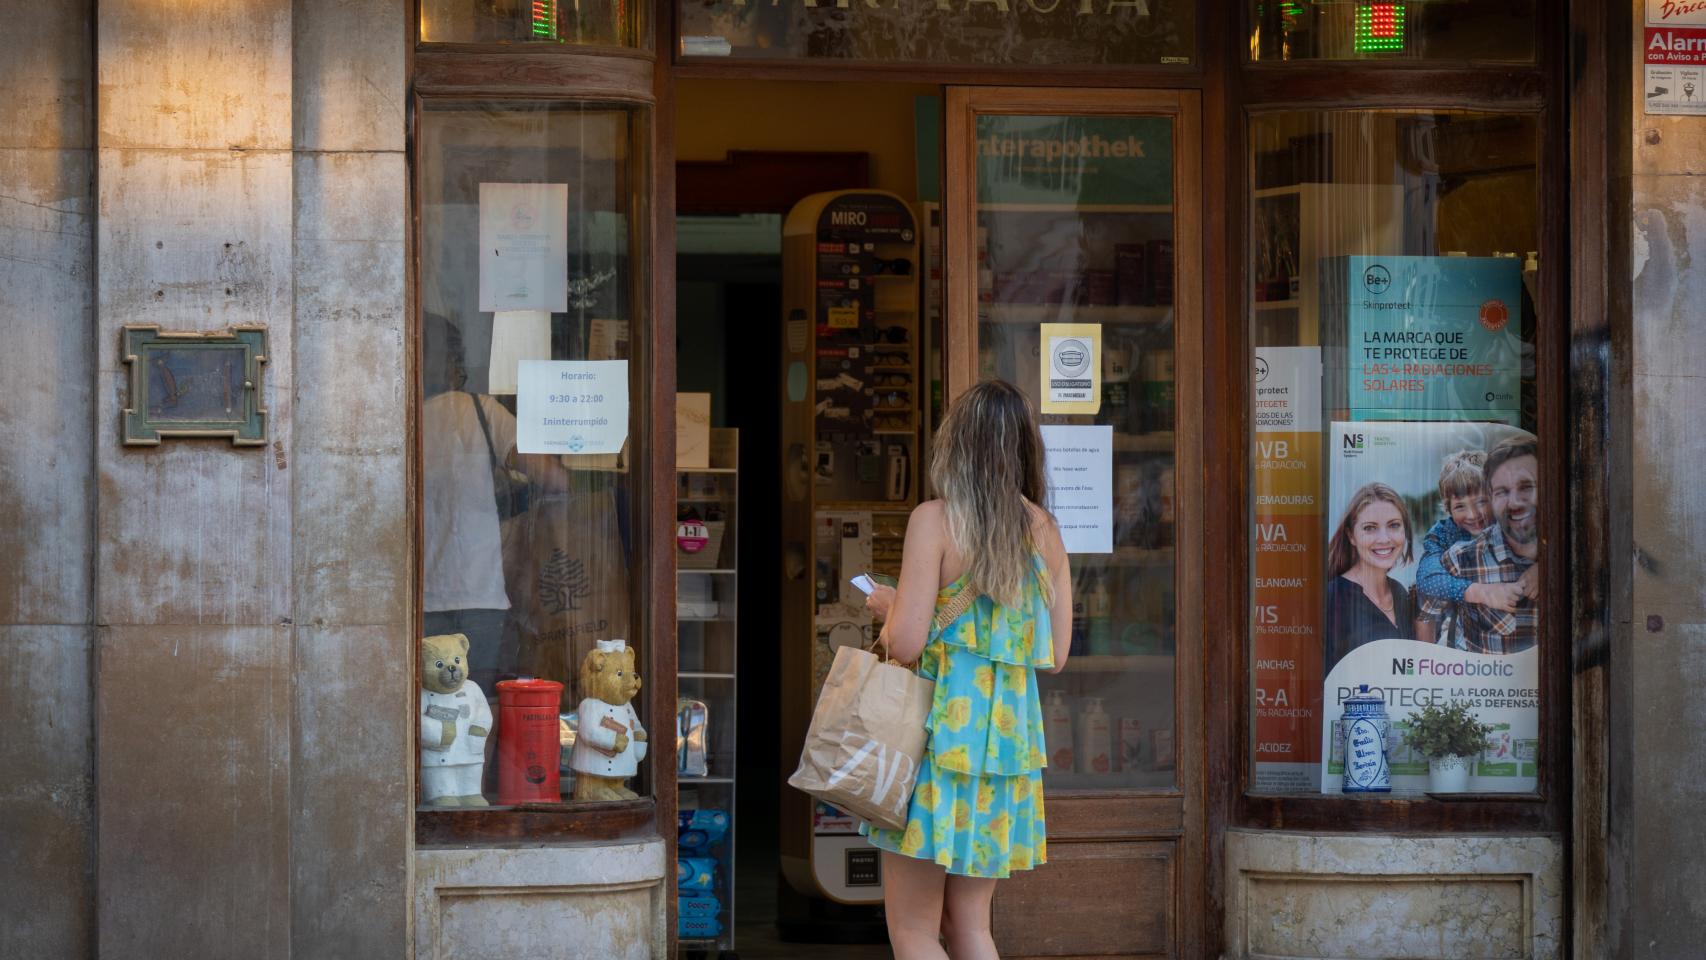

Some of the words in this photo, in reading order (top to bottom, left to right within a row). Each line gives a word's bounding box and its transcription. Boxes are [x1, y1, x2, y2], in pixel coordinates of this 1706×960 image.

[1648, 53, 1664, 61] con
[1666, 52, 1691, 61] Aviso
[831, 211, 867, 226] MIRO
[1367, 274, 1388, 285] Be+
[1363, 300, 1410, 310] Skinprotect
[1364, 332, 1381, 344] LA
[1383, 332, 1433, 344] MARCA
[1435, 332, 1463, 345] QUE
[1364, 347, 1381, 359] TE
[1384, 347, 1447, 359] PROTEGE
[1449, 347, 1468, 359] DE
[1364, 363, 1389, 375] LAS
[1391, 363, 1401, 375] 4
[1403, 363, 1493, 376] RADIACIONES
[561, 371, 597, 380] Horario:
[1363, 379, 1425, 391] SOLARES
[549, 394, 570, 403] 9:30
[580, 394, 604, 403] 22:00
[543, 417, 608, 427] Ininterrumpido
[1268, 624, 1312, 634] RADIACIÓN
[1418, 659, 1513, 677] Florabiotic
[1450, 688, 1465, 697] LA
[1467, 688, 1504, 697] FLORA
[1460, 699, 1482, 708] LAS
[1268, 707, 1312, 718] RADIACIÓN
[1256, 742, 1292, 752] ACIDEZ
